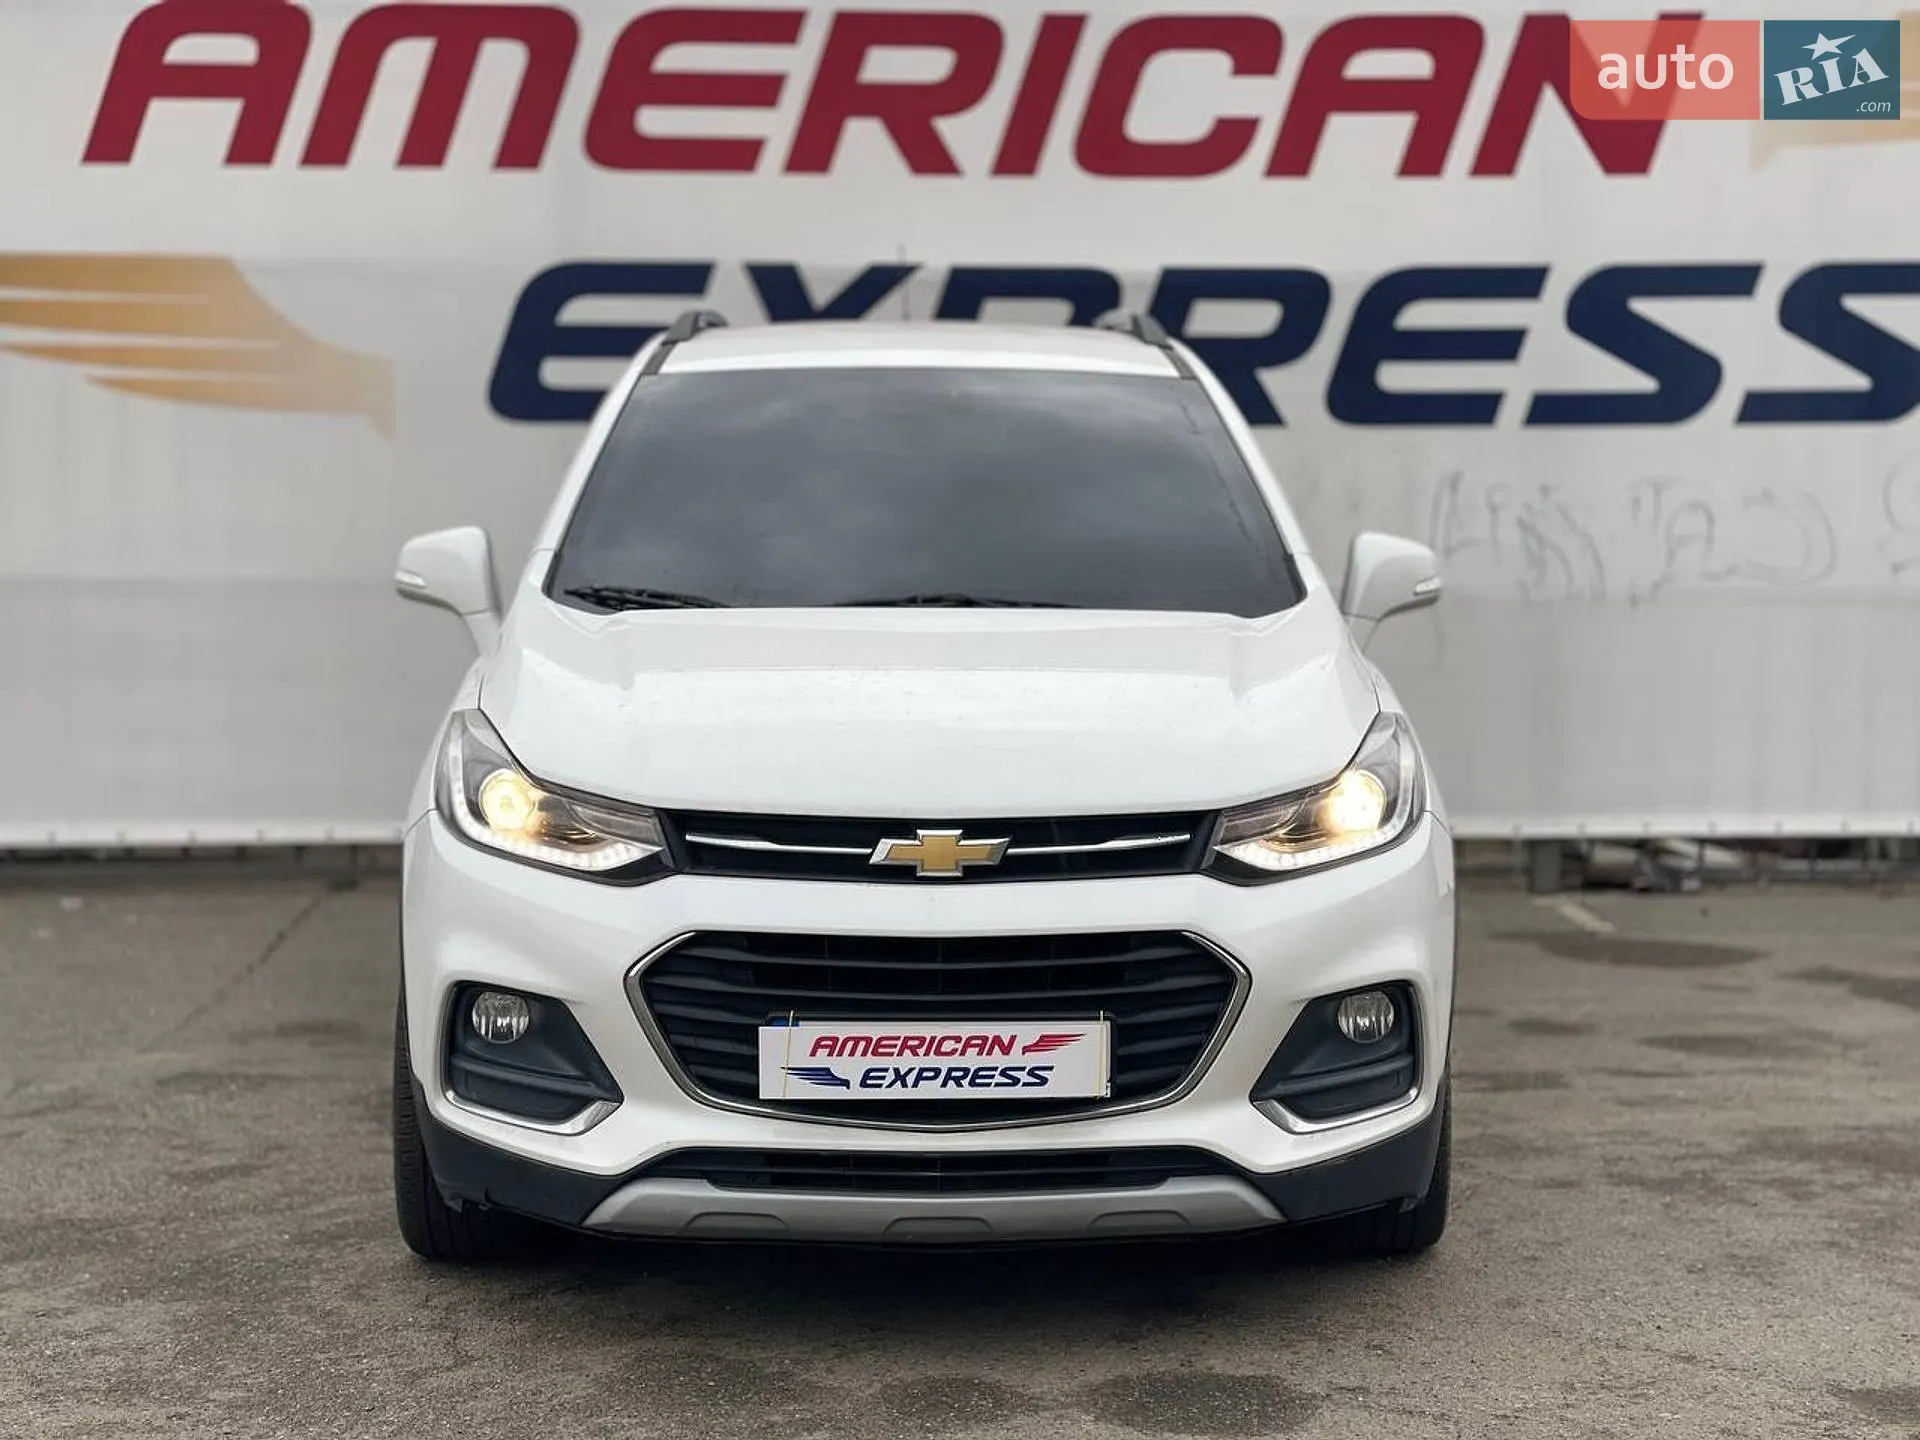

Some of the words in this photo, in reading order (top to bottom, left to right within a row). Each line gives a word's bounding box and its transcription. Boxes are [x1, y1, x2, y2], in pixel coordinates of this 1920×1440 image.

[81, 0, 1703, 177] AMERICAN
[808, 1034, 1017, 1058] AMERICAN
[859, 1064, 1054, 1090] EXPRESS
